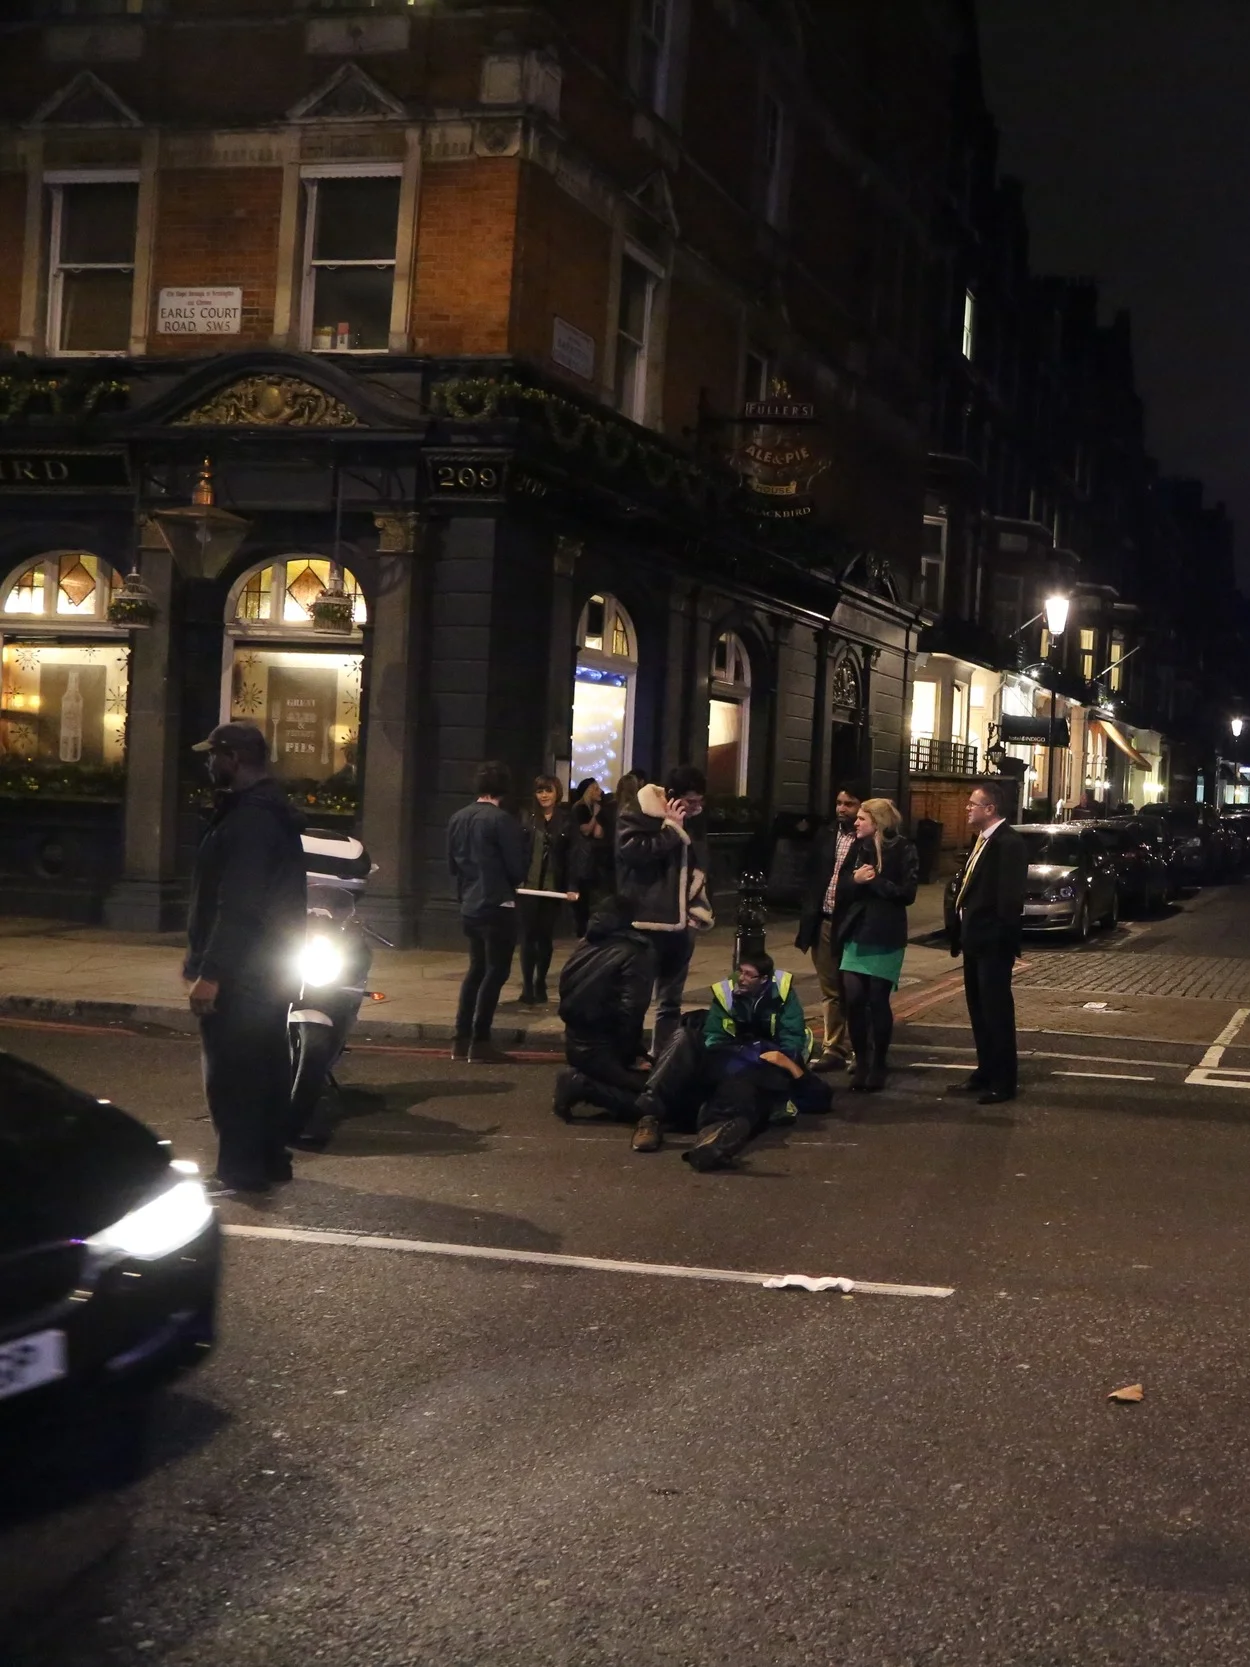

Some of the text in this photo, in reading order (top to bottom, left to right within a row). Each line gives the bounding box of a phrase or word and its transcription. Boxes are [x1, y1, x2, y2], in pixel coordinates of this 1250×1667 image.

[161, 308, 239, 319] EARLS COURT
[745, 446, 772, 464] ALE
[785, 447, 810, 464] PIE
[438, 467, 497, 488] 209
